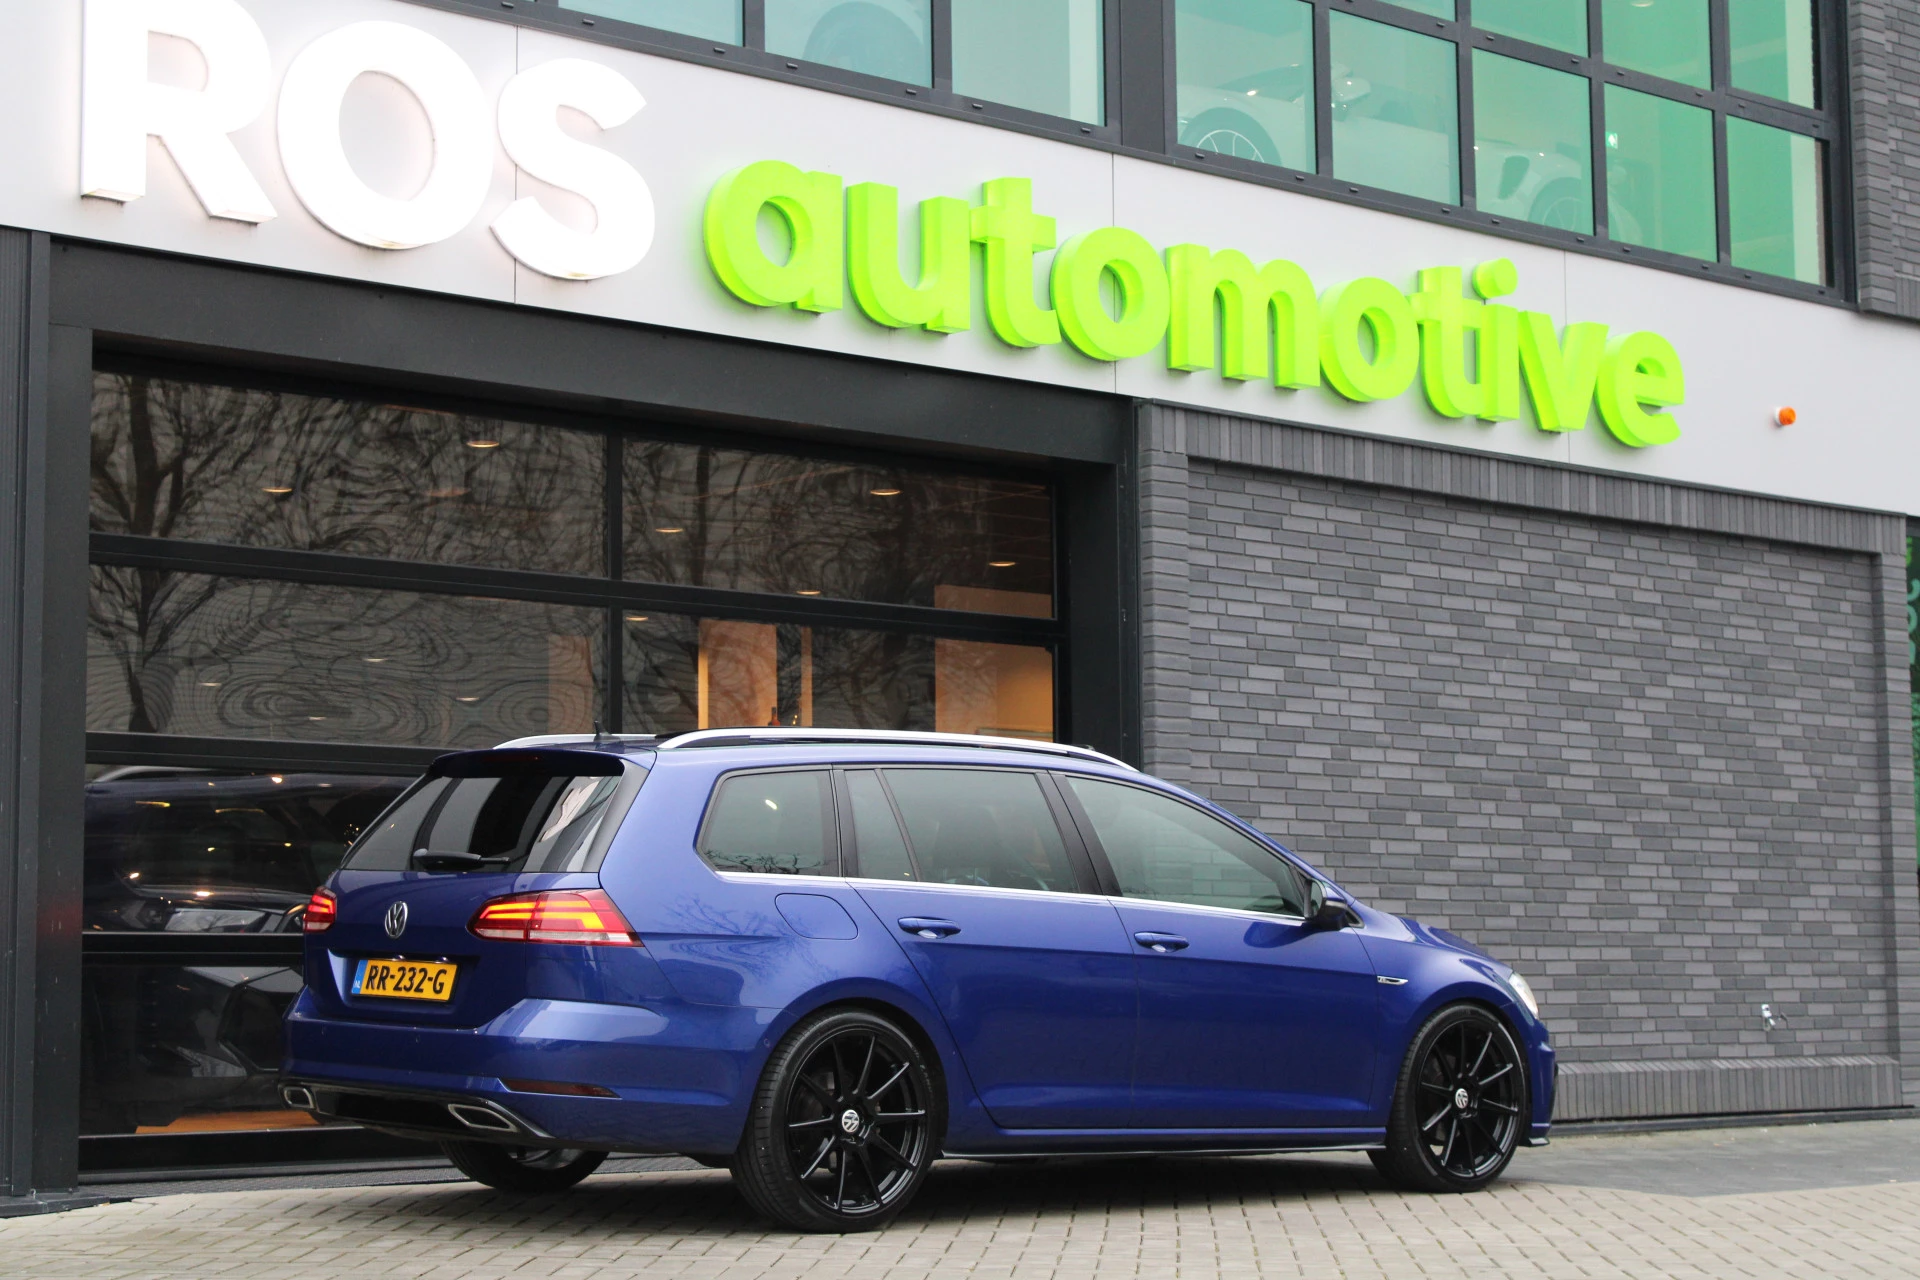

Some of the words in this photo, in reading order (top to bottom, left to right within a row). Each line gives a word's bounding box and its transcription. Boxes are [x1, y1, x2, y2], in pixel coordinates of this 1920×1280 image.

[81, 0, 655, 281] ROS
[703, 159, 1686, 448] automotive
[365, 965, 447, 995] RR-232-G
